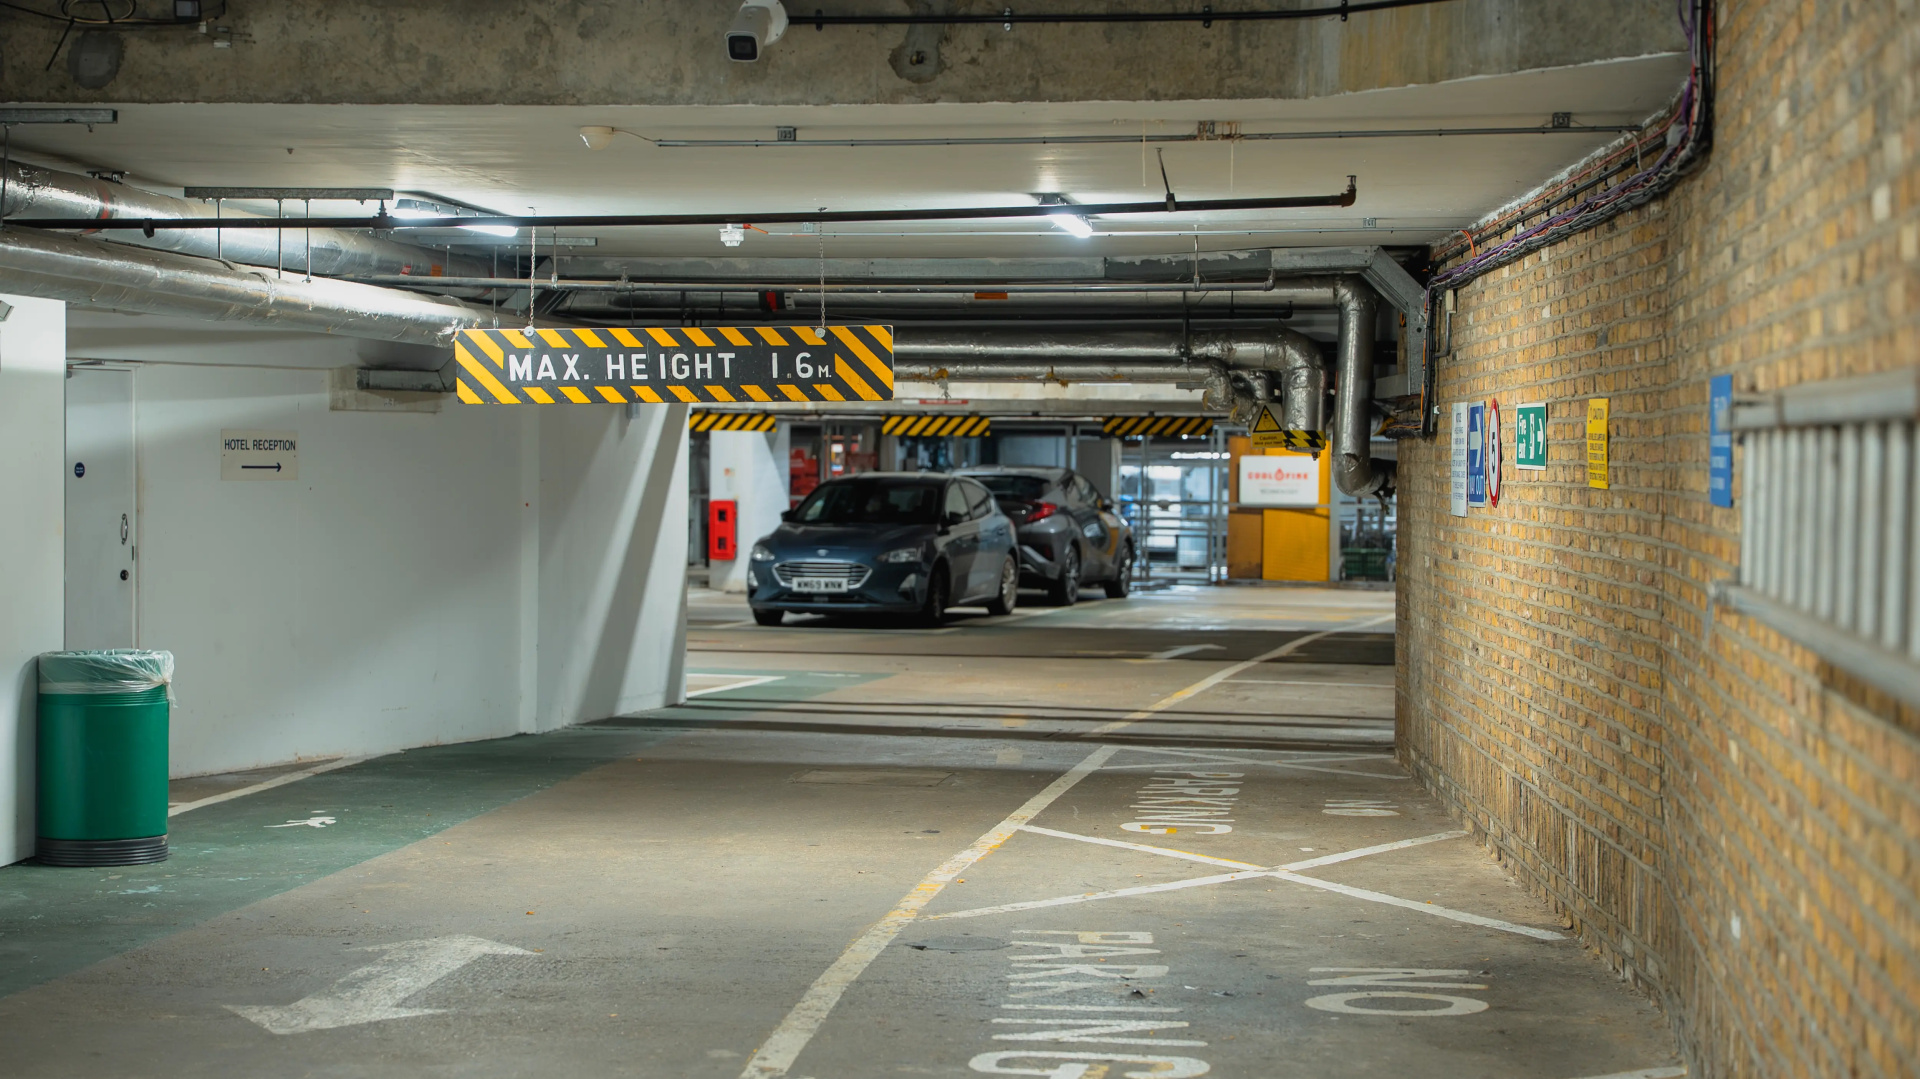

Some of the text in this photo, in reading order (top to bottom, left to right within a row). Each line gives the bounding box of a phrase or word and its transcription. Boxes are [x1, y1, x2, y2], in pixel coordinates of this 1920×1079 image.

[508, 353, 590, 381] MAX.
[606, 352, 736, 381] HEIGHT
[224, 439, 296, 451] HOTEL RECEPTION
[1491, 431, 1496, 474] 5
[1119, 769, 1245, 835] PARKING
[1321, 799, 1400, 817] NO
[967, 928, 1212, 1079] PARKING
[1304, 966, 1490, 1018] NO
